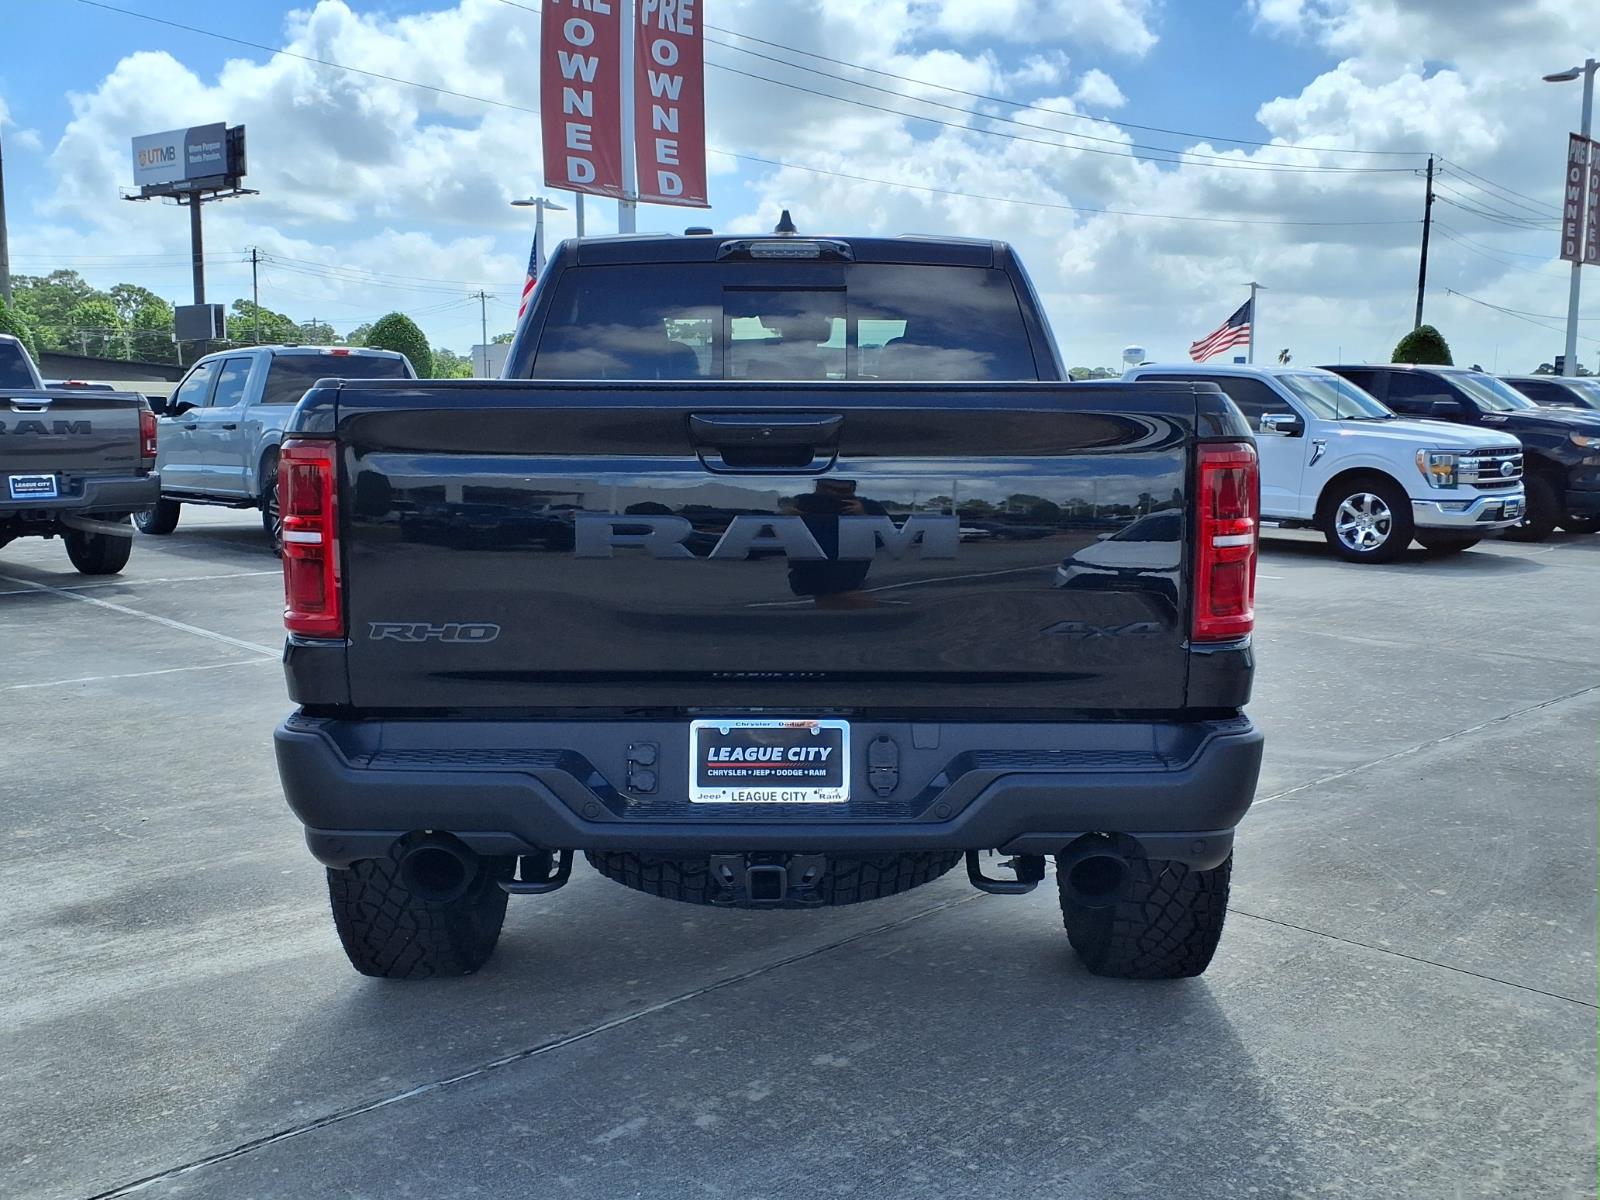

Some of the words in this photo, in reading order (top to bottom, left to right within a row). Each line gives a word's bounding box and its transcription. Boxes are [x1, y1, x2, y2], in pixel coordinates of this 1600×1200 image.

[641, 0, 694, 36] PRE
[557, 17, 599, 184] OWNED
[647, 38, 684, 196] OWNED
[147, 146, 176, 164] UTMB
[1566, 167, 1580, 255] OWNED
[0, 420, 92, 435] AM
[574, 514, 961, 561] RAM
[368, 622, 501, 643] RHO
[707, 747, 784, 761] LEAGUE
[787, 747, 833, 761] CITY
[697, 792, 722, 800] Jeep
[731, 791, 778, 801] LEAGUE
[781, 791, 808, 801] CITY
